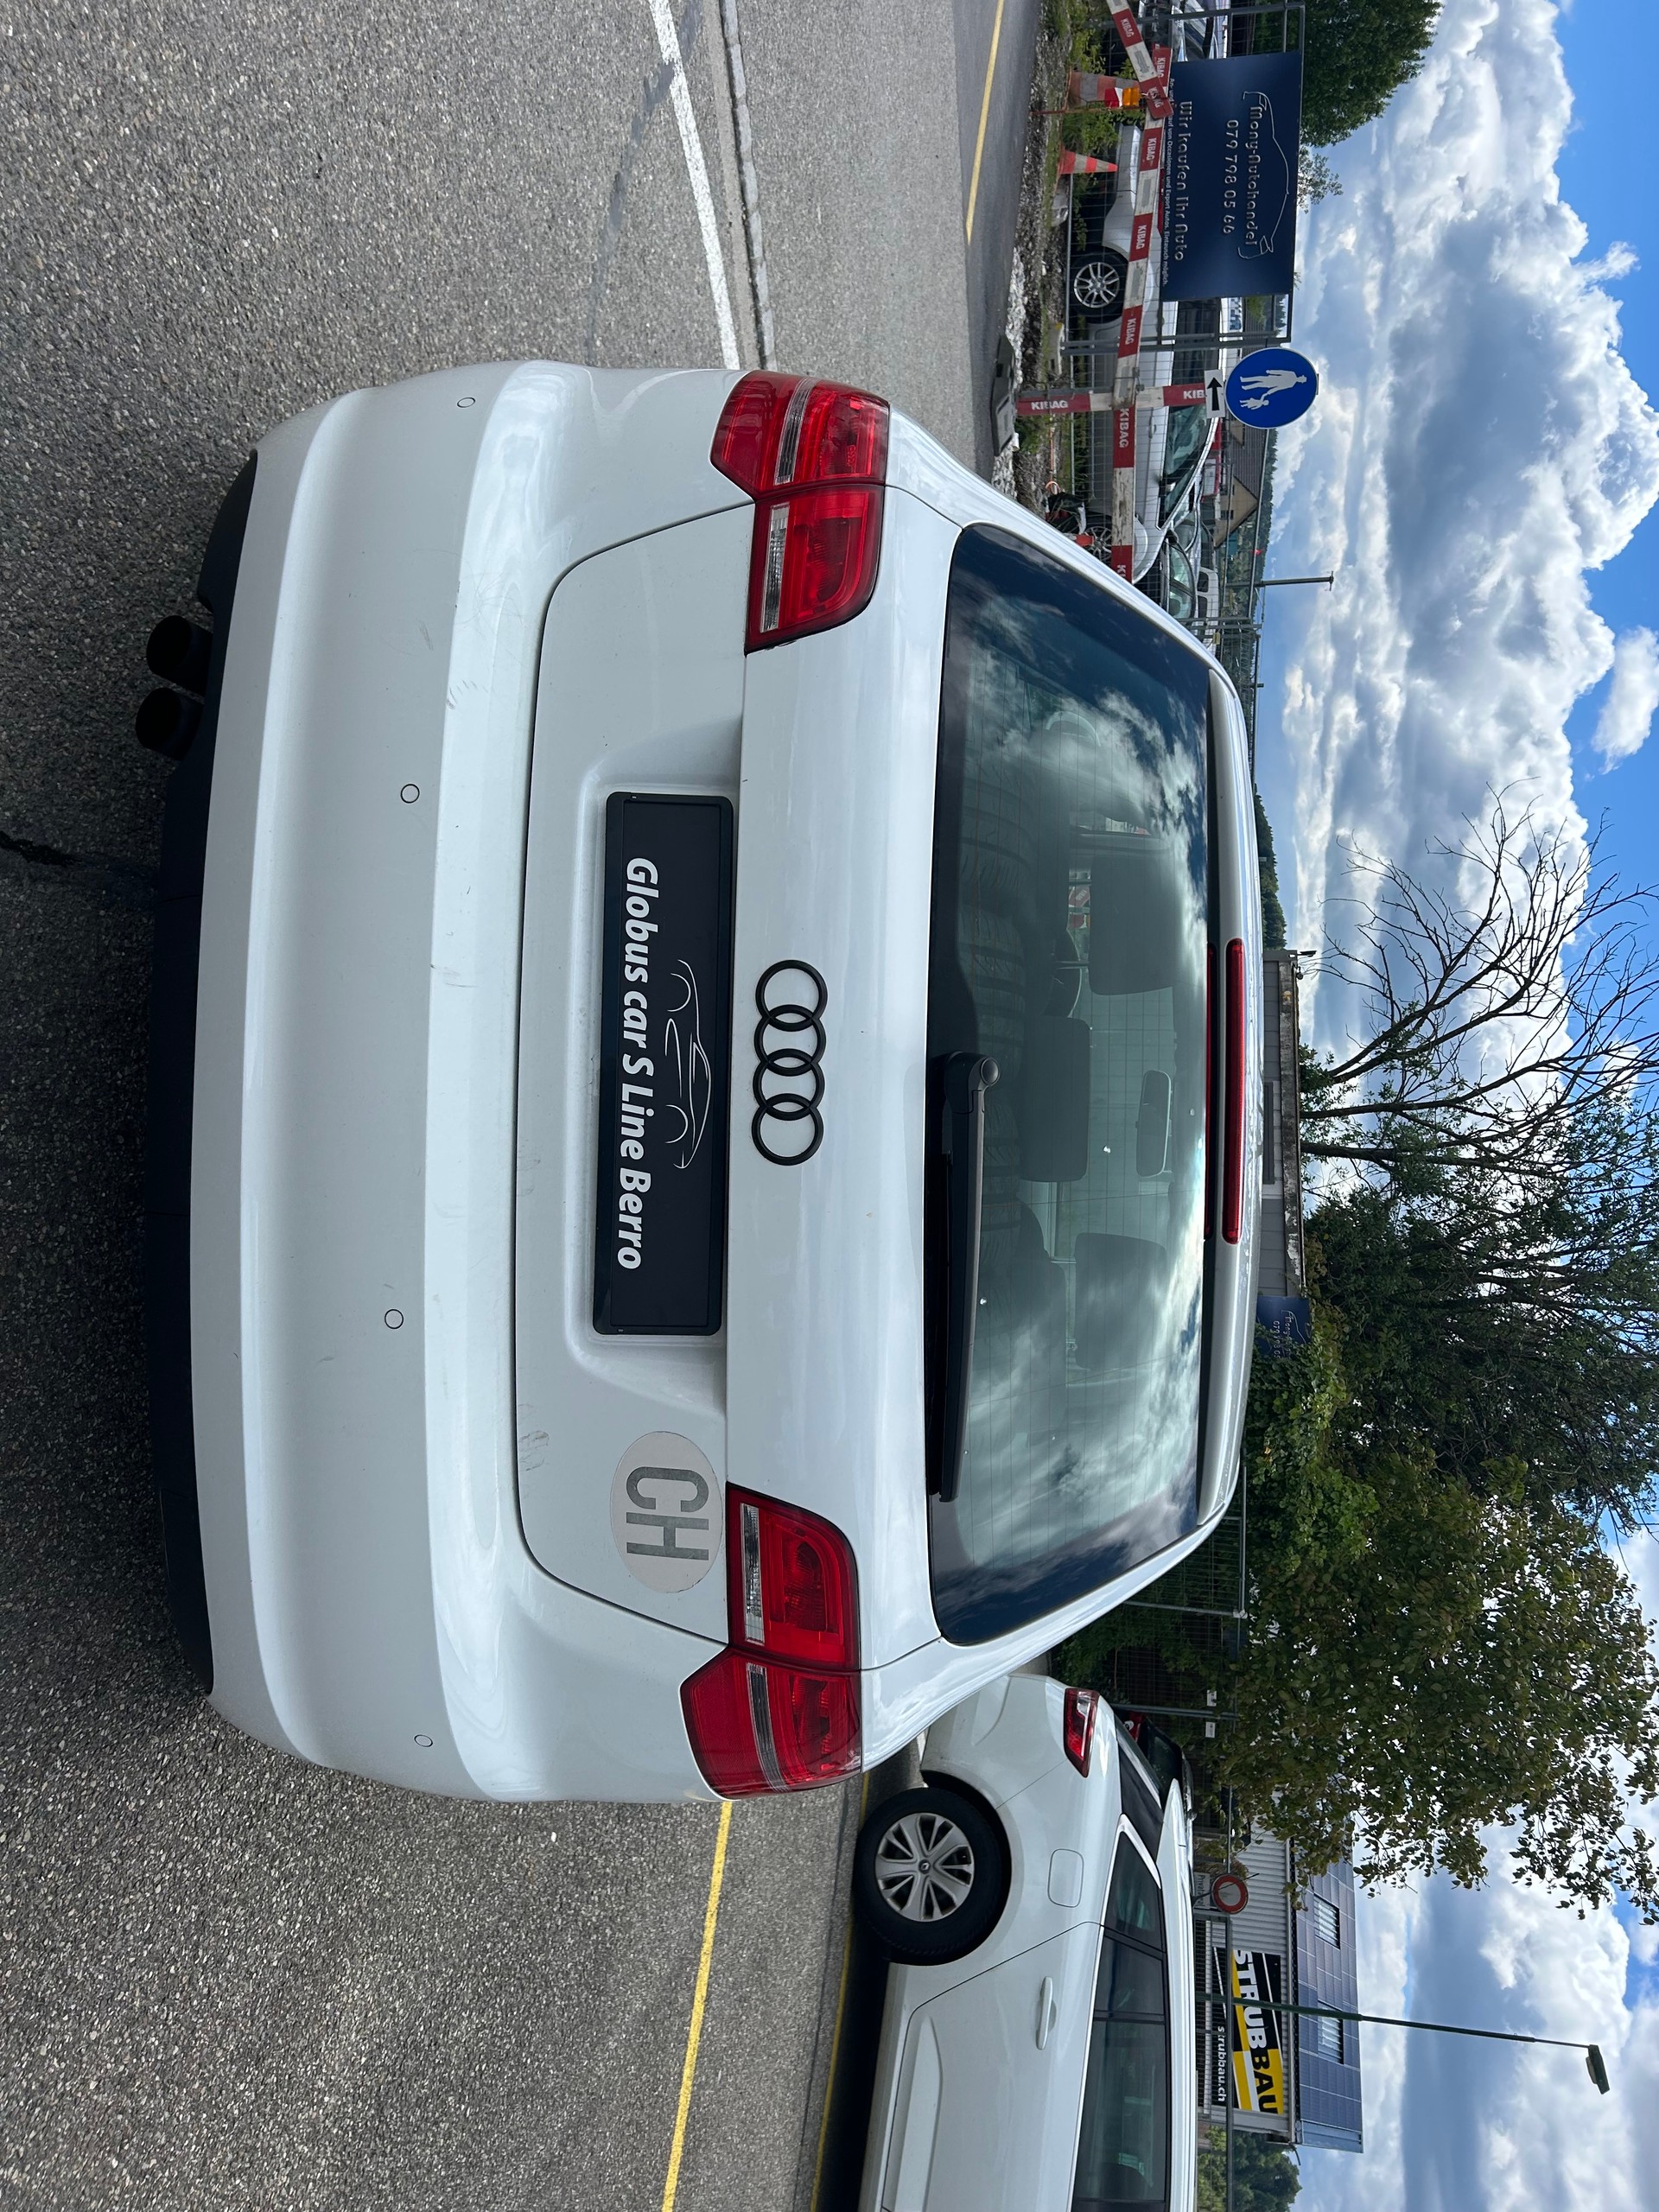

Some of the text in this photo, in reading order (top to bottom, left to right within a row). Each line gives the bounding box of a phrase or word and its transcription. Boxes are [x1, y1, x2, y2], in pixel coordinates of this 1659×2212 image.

[1120, 18, 1134, 38] KIBAG
[1156, 57, 1166, 78] KIBAG
[1225, 119, 1239, 149] 079
[1146, 138, 1156, 161] KIBAG
[1173, 101, 1192, 261] Wir kaufen Ihr Auto
[1224, 155, 1237, 183] 798
[1245, 106, 1262, 245] Mony-Autohandel
[1224, 190, 1236, 208] 05
[1135, 225, 1147, 249] KIBAG
[1125, 318, 1136, 346] KIBAG
[1183, 390, 1205, 399] KIB
[1119, 408, 1129, 448] KIBAG
[617, 857, 659, 1269] Globus car S Line Berro
[626, 1466, 709, 1560] CH
